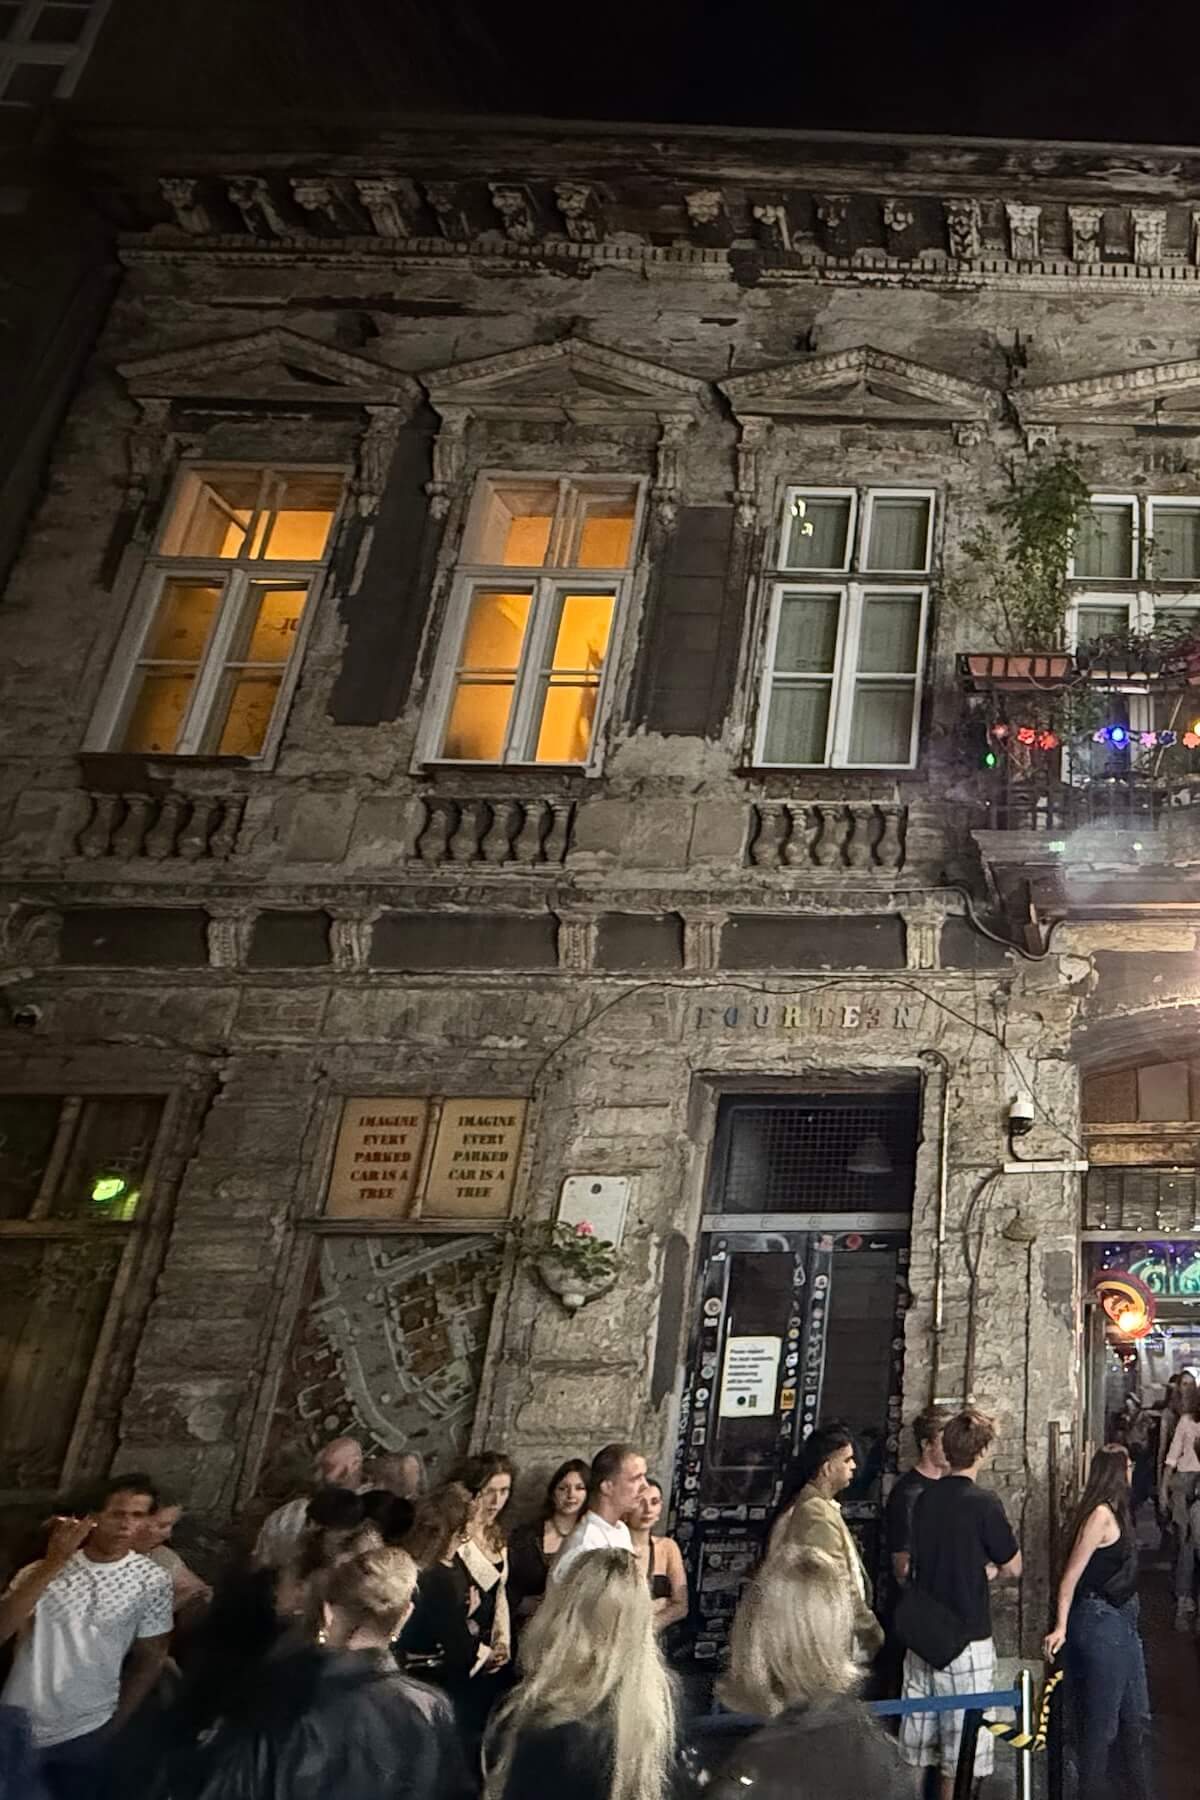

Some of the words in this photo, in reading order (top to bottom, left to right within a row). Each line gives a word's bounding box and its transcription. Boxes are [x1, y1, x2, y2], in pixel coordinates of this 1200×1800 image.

[359, 1115, 418, 1128] IMAGINE
[458, 1115, 516, 1127] IMAGINE
[363, 1134, 408, 1145] EVERY
[462, 1134, 505, 1145] EVERY
[353, 1151, 411, 1163] PARKED
[452, 1151, 509, 1162] PARKED
[350, 1170, 379, 1181] CAR
[381, 1169, 397, 1181] IS
[399, 1169, 409, 1181] A
[447, 1169, 476, 1181] CAR
[480, 1169, 494, 1181] IS
[495, 1169, 505, 1180] A
[359, 1187, 396, 1199] TREE
[455, 1187, 494, 1198] TREE
